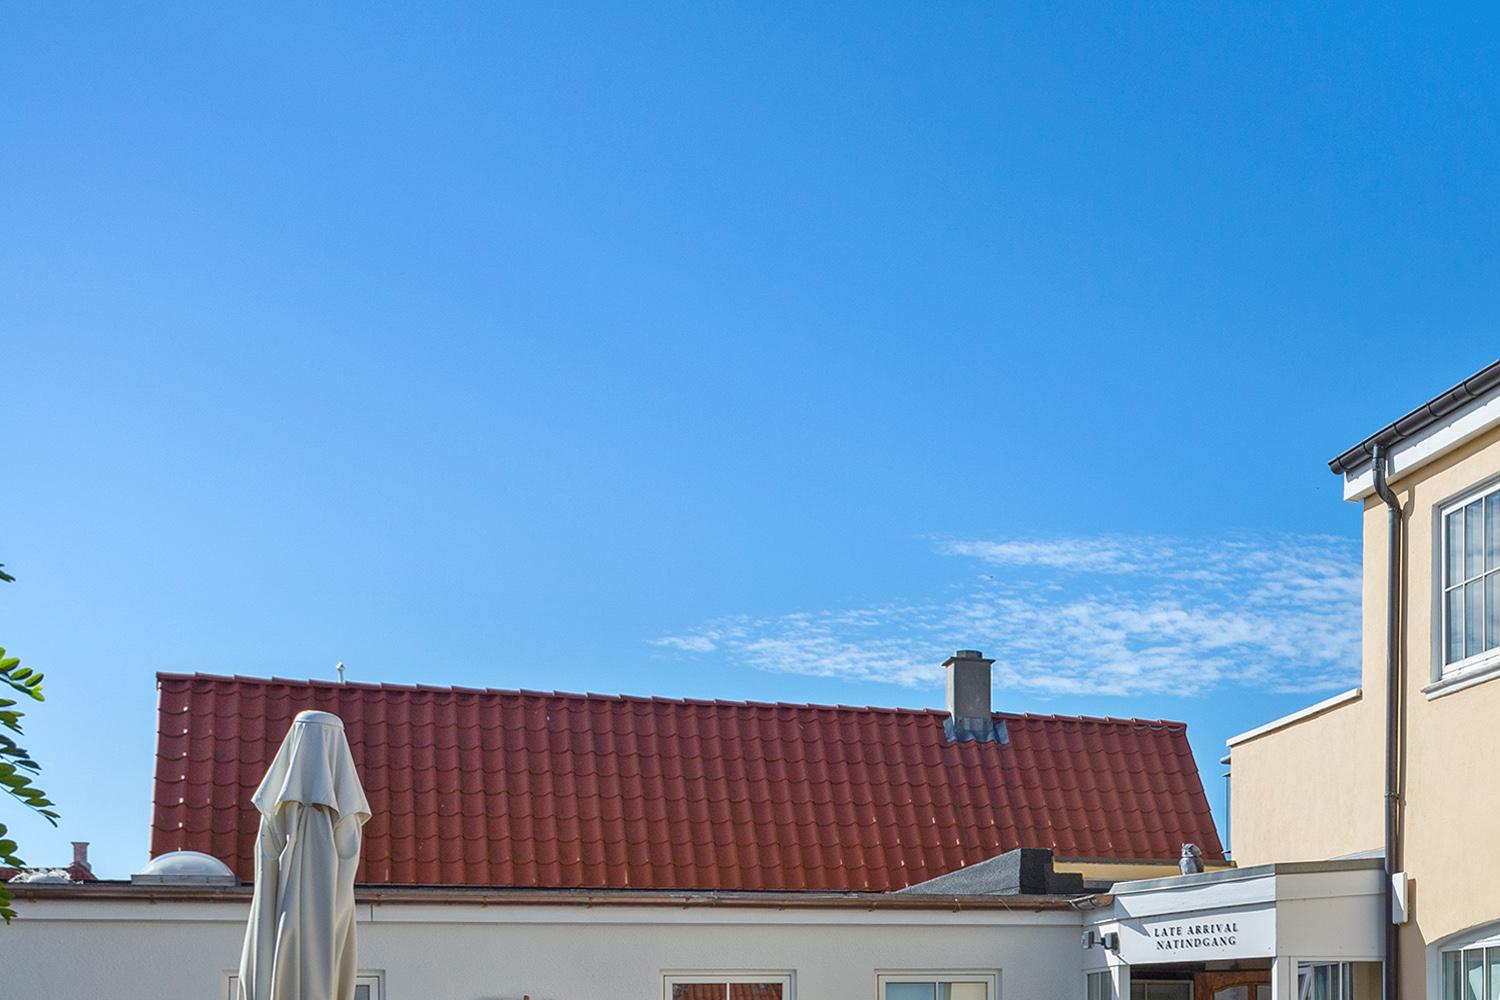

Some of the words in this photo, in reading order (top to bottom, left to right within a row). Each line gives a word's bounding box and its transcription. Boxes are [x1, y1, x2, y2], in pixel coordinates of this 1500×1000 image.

[1154, 926, 1182, 937] LATE
[1187, 923, 1239, 935] ARRIVAL
[1156, 936, 1236, 949] NATINDGANG
